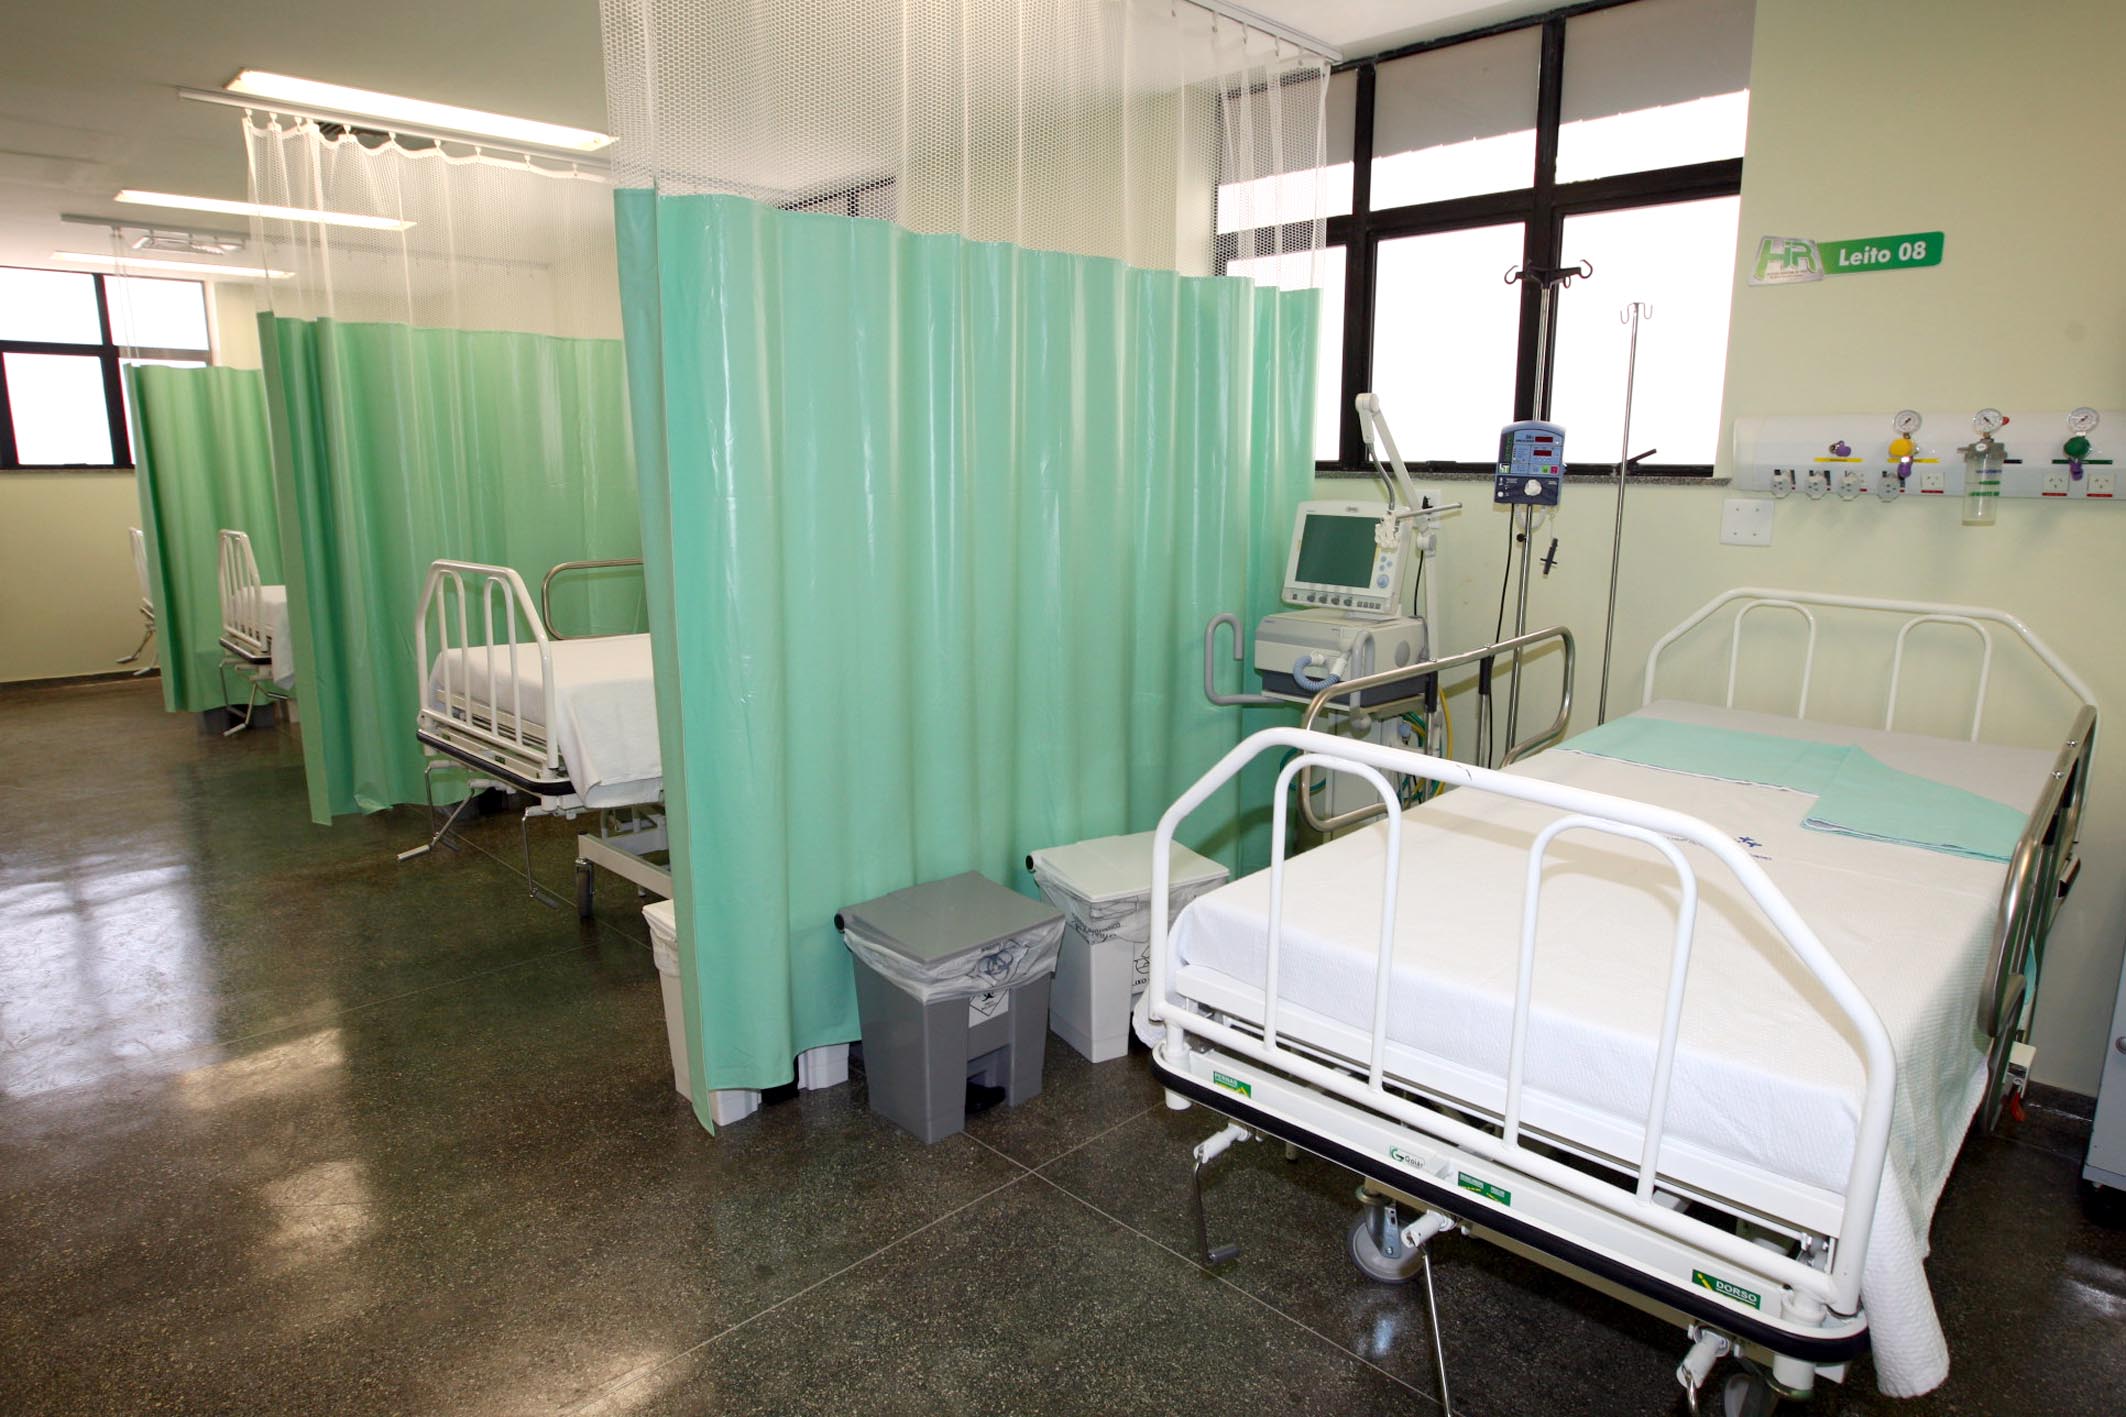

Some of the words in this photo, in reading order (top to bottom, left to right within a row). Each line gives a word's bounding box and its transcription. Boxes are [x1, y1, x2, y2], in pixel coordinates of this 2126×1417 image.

[1839, 246, 1891, 266] Leito
[1898, 241, 1927, 261] 08
[1716, 1281, 1757, 1302] DORSO
